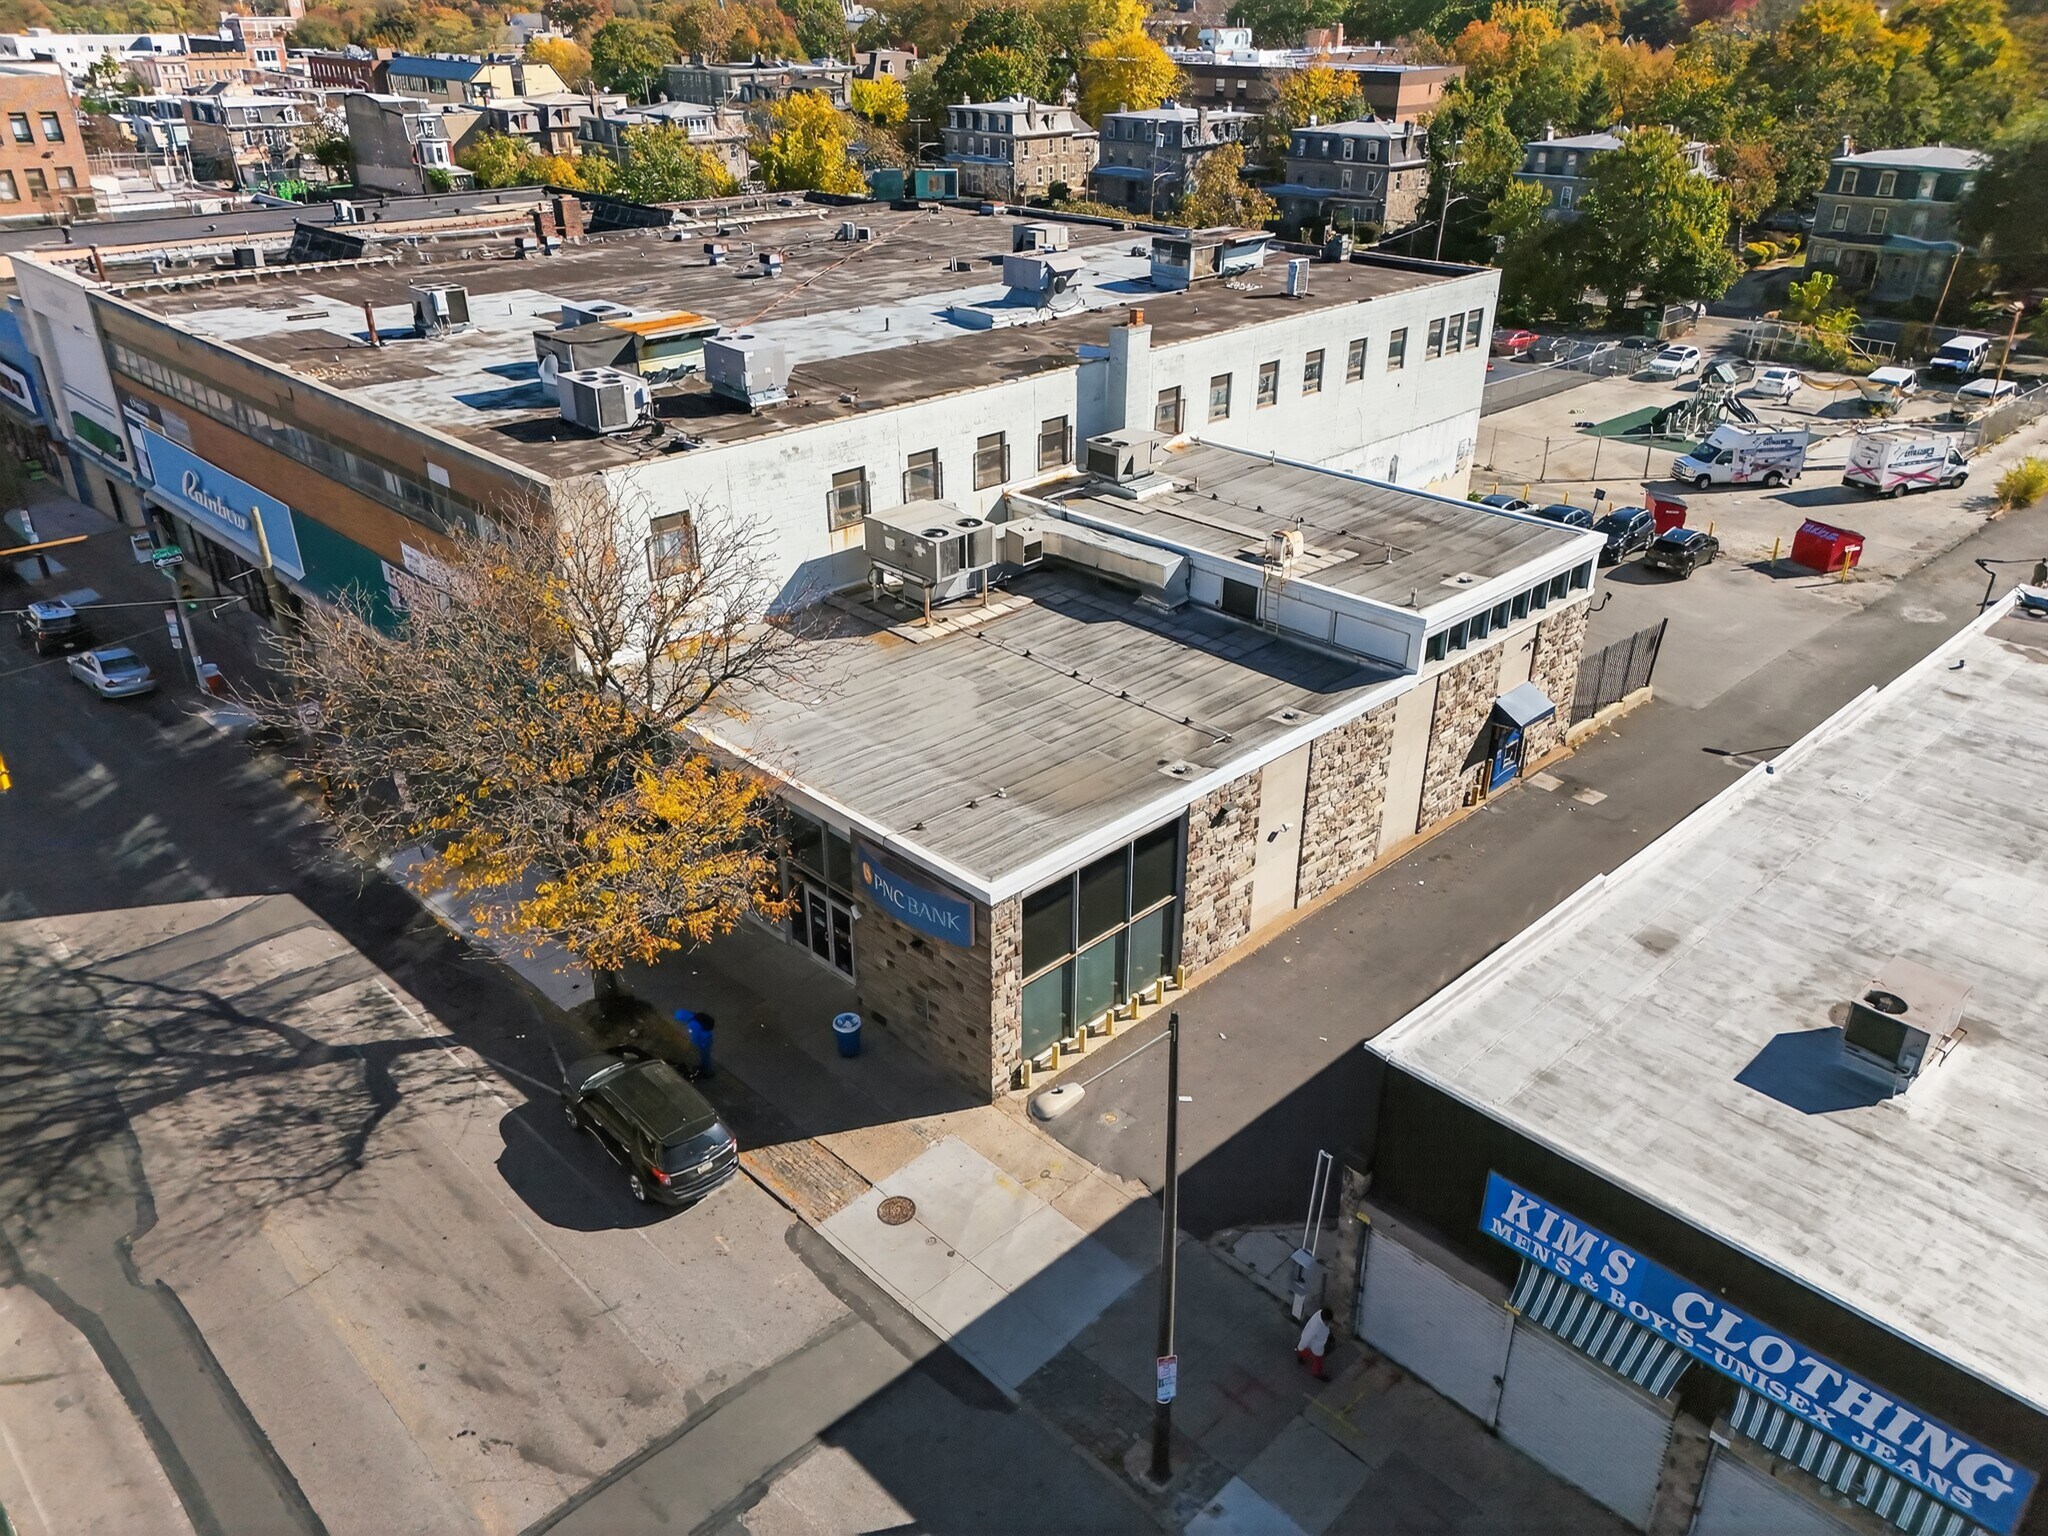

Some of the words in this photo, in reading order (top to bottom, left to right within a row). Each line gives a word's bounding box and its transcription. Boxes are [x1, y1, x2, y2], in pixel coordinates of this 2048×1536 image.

[183, 471, 246, 531] Rainbow
[874, 874, 905, 909] PNC
[907, 897, 961, 932] BANK
[1491, 1218, 1572, 1276] MEN'S
[1580, 1272, 1599, 1293] &
[1852, 1431, 1973, 1509] JEANS
[1502, 1190, 1636, 1286] KIM'S
[1673, 1292, 2014, 1502] CLOTHING
